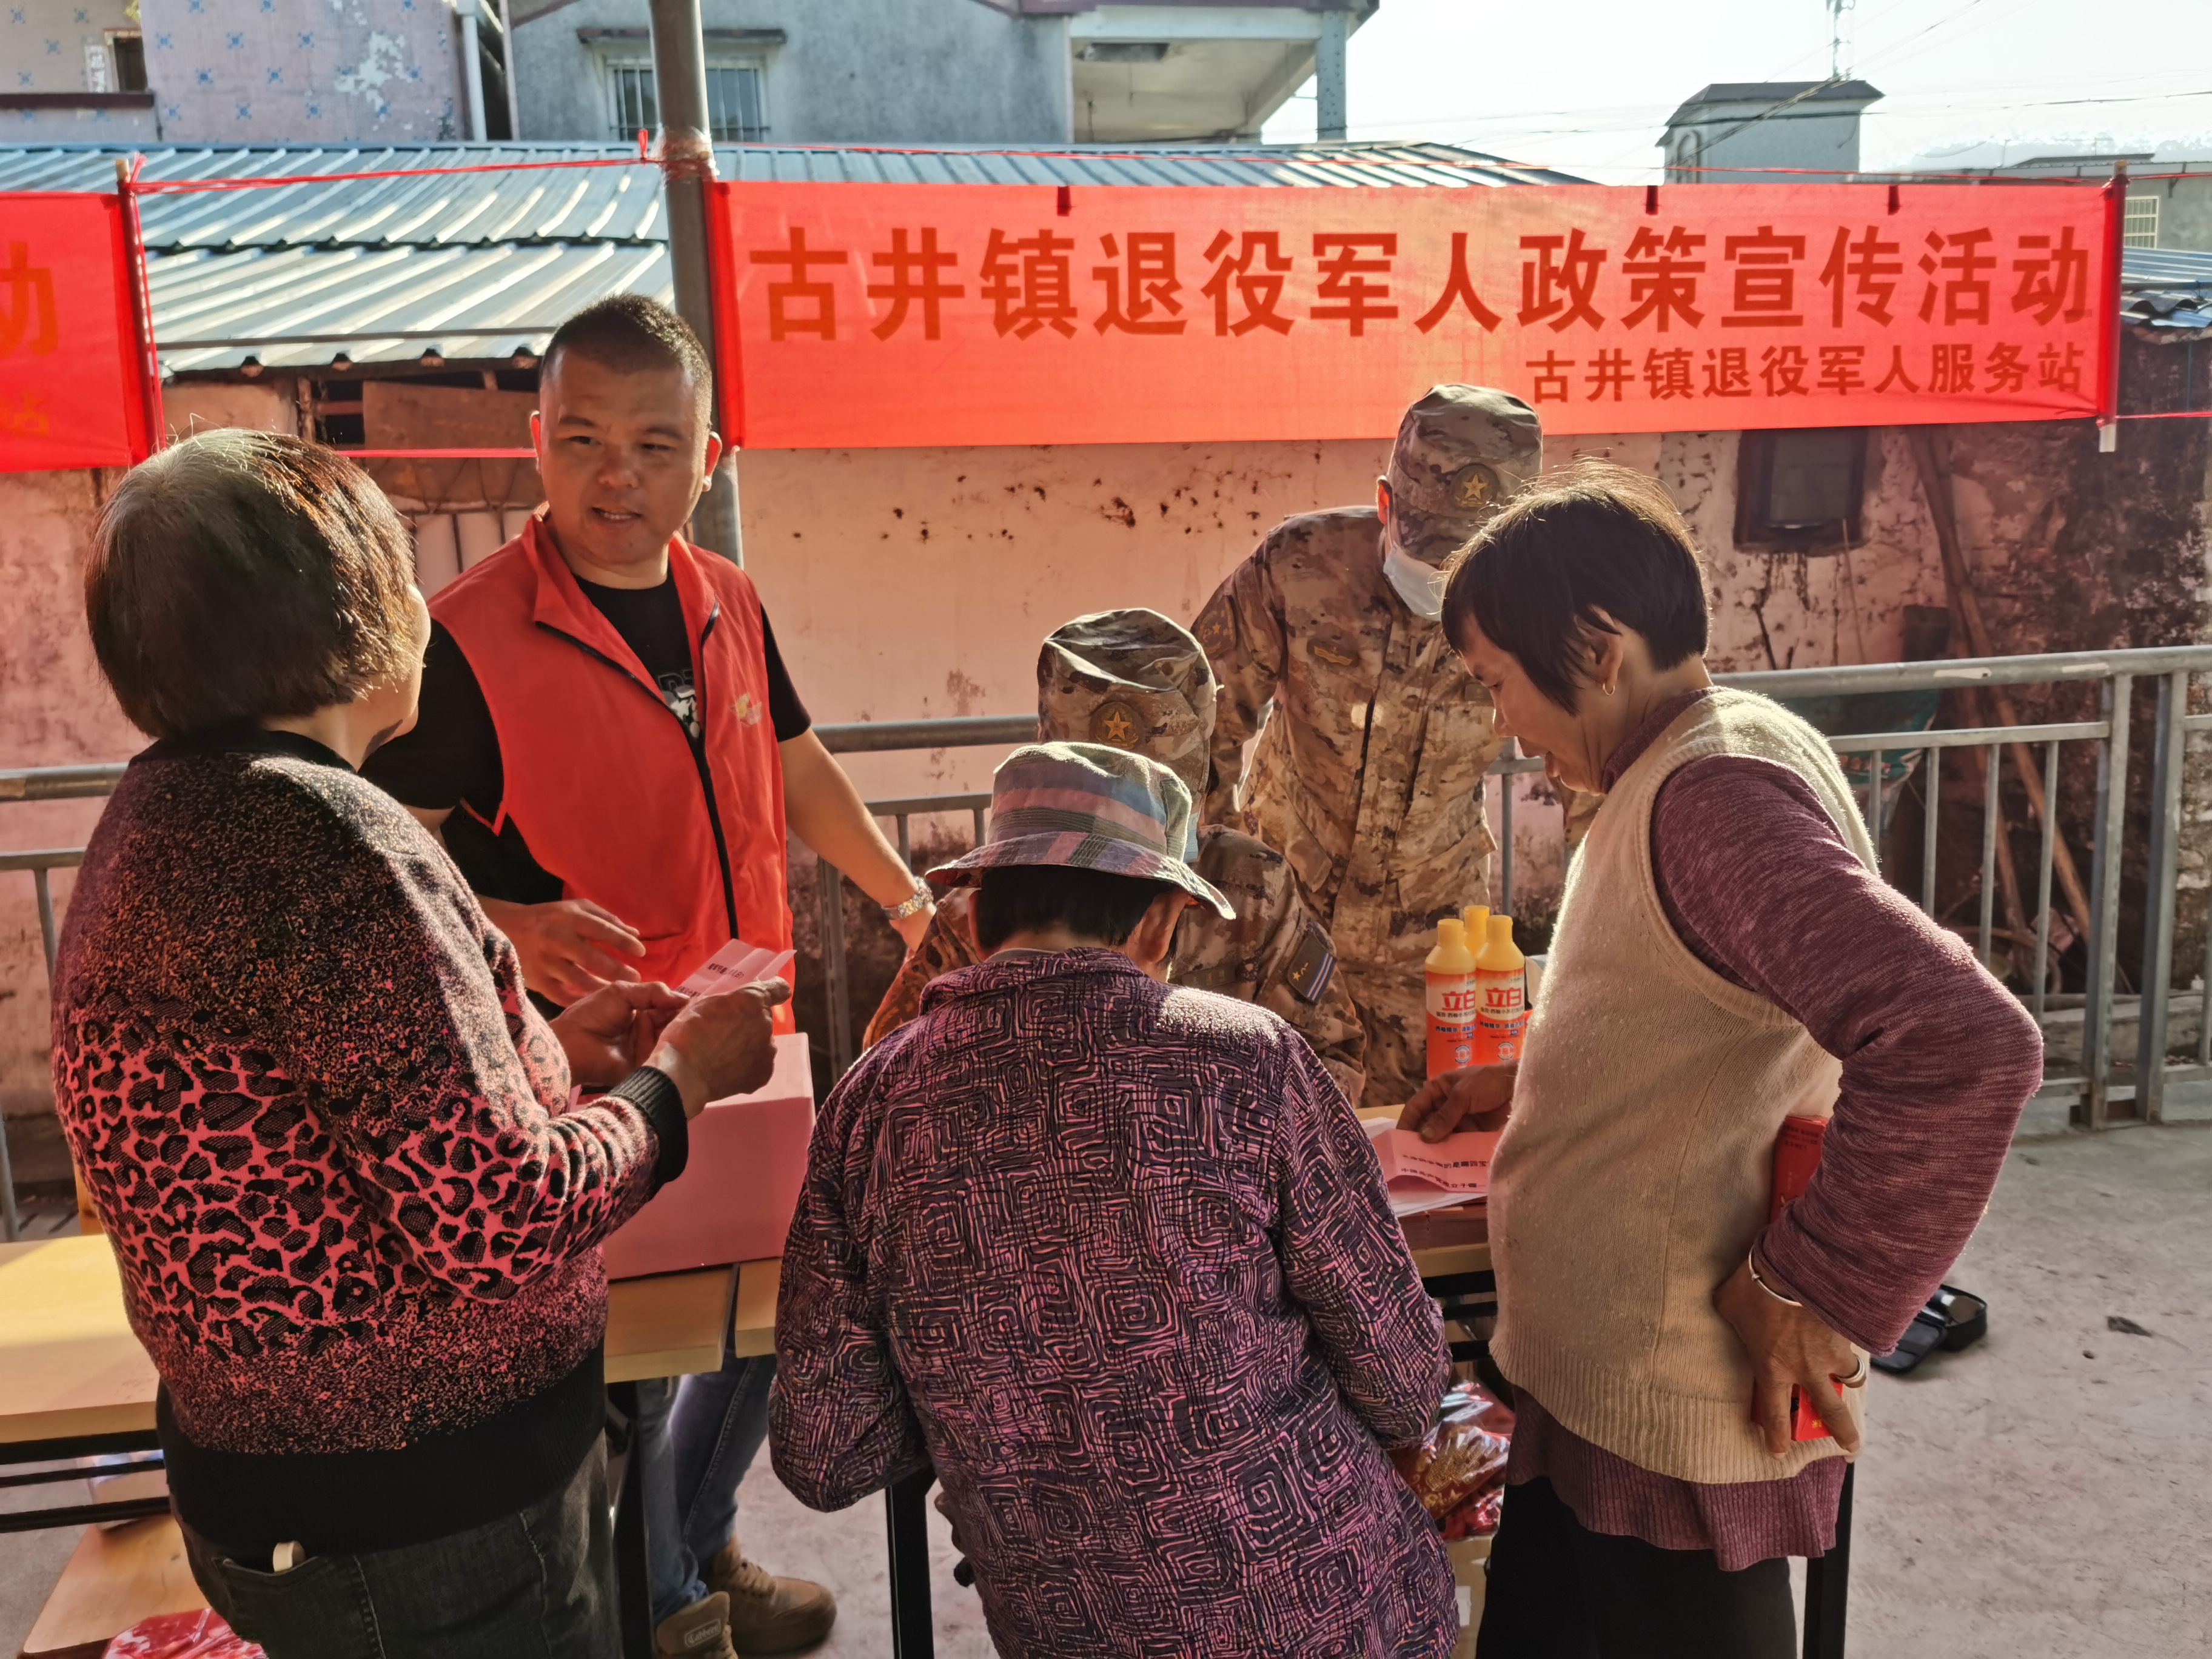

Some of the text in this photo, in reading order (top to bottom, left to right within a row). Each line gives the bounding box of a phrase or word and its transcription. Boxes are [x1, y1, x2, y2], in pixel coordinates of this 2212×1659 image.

[749, 226, 2088, 342] 古井镇退役军人政策宣传活动
[1526, 341, 2084, 404] 古井镇退役军人服务站
[1486, 987, 1521, 1007] 立白
